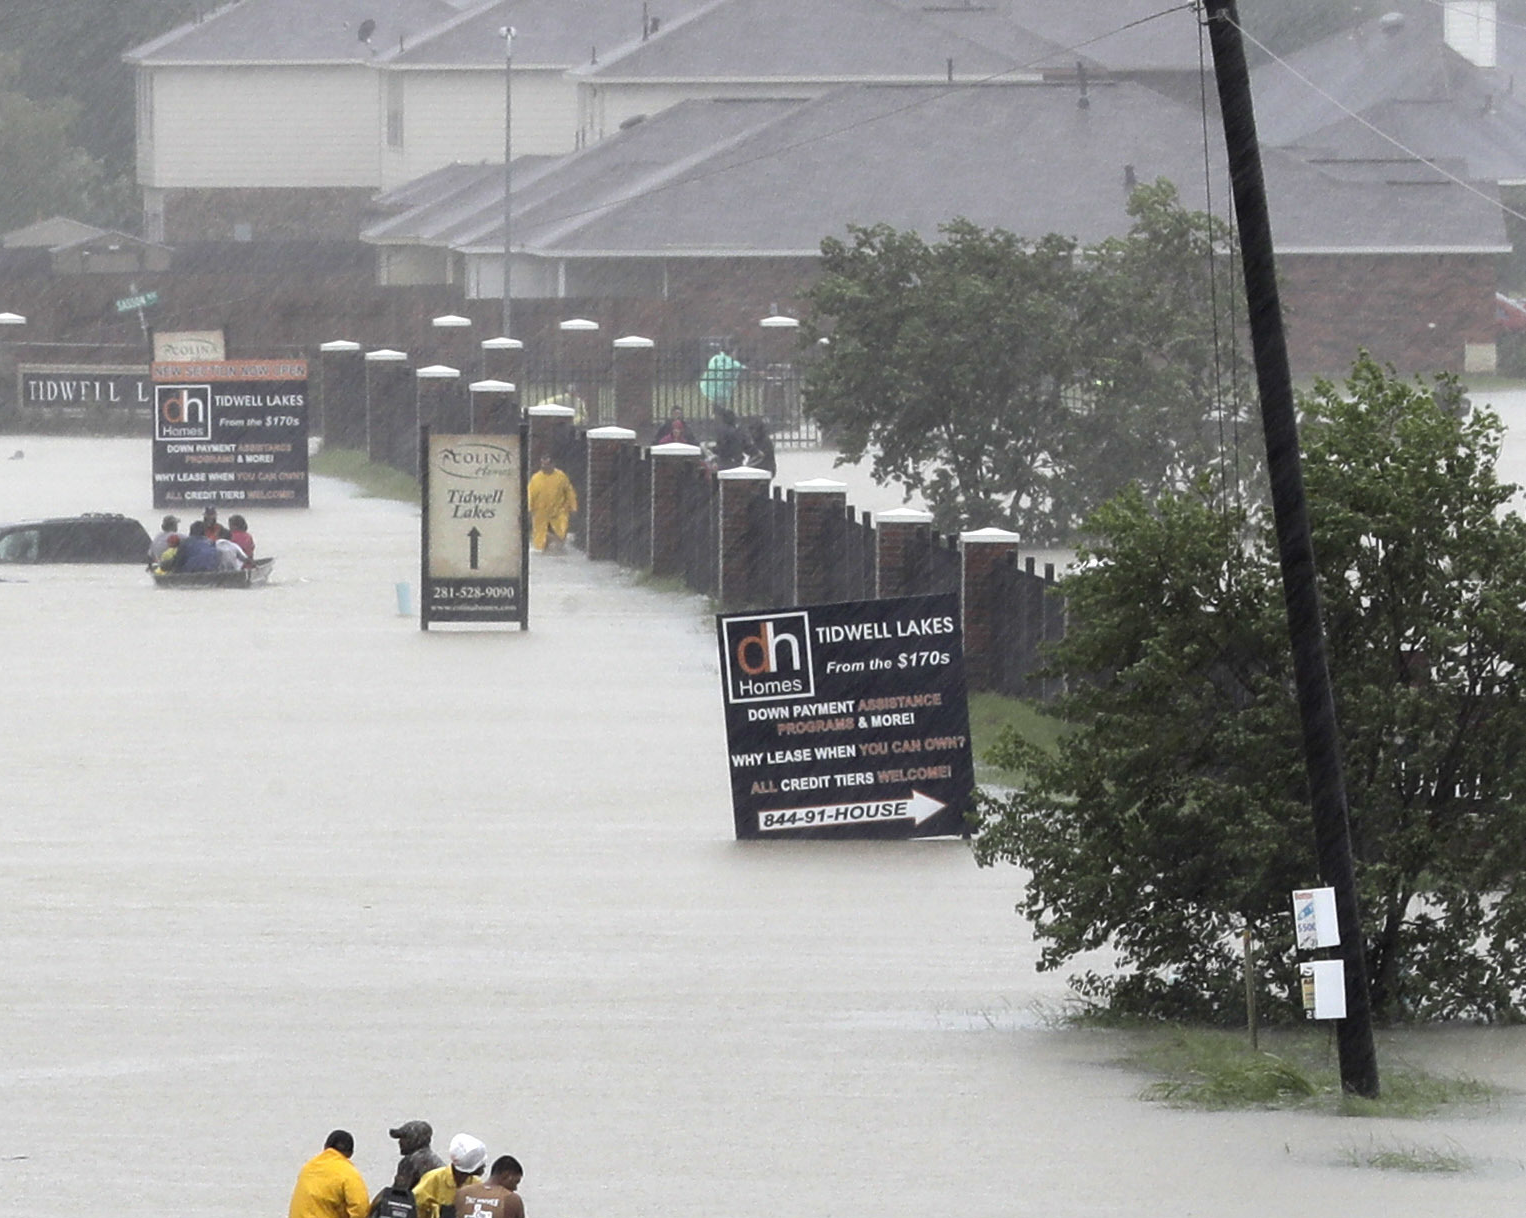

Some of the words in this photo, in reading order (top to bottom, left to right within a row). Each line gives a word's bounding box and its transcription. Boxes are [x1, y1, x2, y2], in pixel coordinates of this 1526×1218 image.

[155, 366, 181, 377] NEW
[186, 366, 236, 377] SECTION
[241, 366, 269, 376] NOW
[272, 365, 305, 376] OPEN
[162, 390, 204, 423] dh
[214, 395, 263, 406] TIDWELL
[266, 395, 304, 406] LAKES
[219, 418, 245, 426] From
[247, 417, 262, 426] the
[265, 416, 300, 427] $170s
[162, 426, 204, 437] Homes
[167, 445, 194, 453] DOWN
[196, 444, 236, 453] PAYMENT
[236, 455, 244, 463] &
[245, 455, 274, 463] MORE!
[155, 473, 175, 482] WHY
[177, 473, 206, 482] LEASE
[208, 473, 235, 481] WHEN
[237, 473, 255, 481] YOU
[165, 492, 182, 500] ALL
[184, 491, 216, 500] CREDIT
[219, 491, 245, 499] TIERS
[447, 490, 504, 504] Tidwell
[452, 505, 496, 519] Lakes
[433, 586, 515, 599] 281-528-9090
[816, 622, 892, 644] TIDWELL
[896, 616, 954, 637] LAKES
[737, 620, 801, 676] dh
[826, 660, 865, 674] From
[869, 657, 892, 671] the
[897, 650, 950, 669] $170s
[739, 678, 803, 696] Homes
[748, 707, 790, 721] DOWN
[793, 700, 855, 718] PAYMENT
[857, 693, 942, 712] ASSISTANCE
[777, 717, 855, 736] PROGRAMS
[858, 716, 868, 728] &
[871, 712, 915, 727] MORE!
[732, 753, 764, 768] WHY
[767, 749, 812, 764] LEASE
[814, 744, 856, 760] WHEN
[858, 743, 889, 756] YOU
[892, 740, 921, 753] CAN
[925, 735, 966, 750] OWN?
[751, 781, 778, 795] ALL
[780, 775, 831, 792] CREDIT
[834, 772, 874, 787] TIERS
[877, 765, 952, 783] WELCOME!
[763, 802, 908, 828] 844-91-HOUSE
